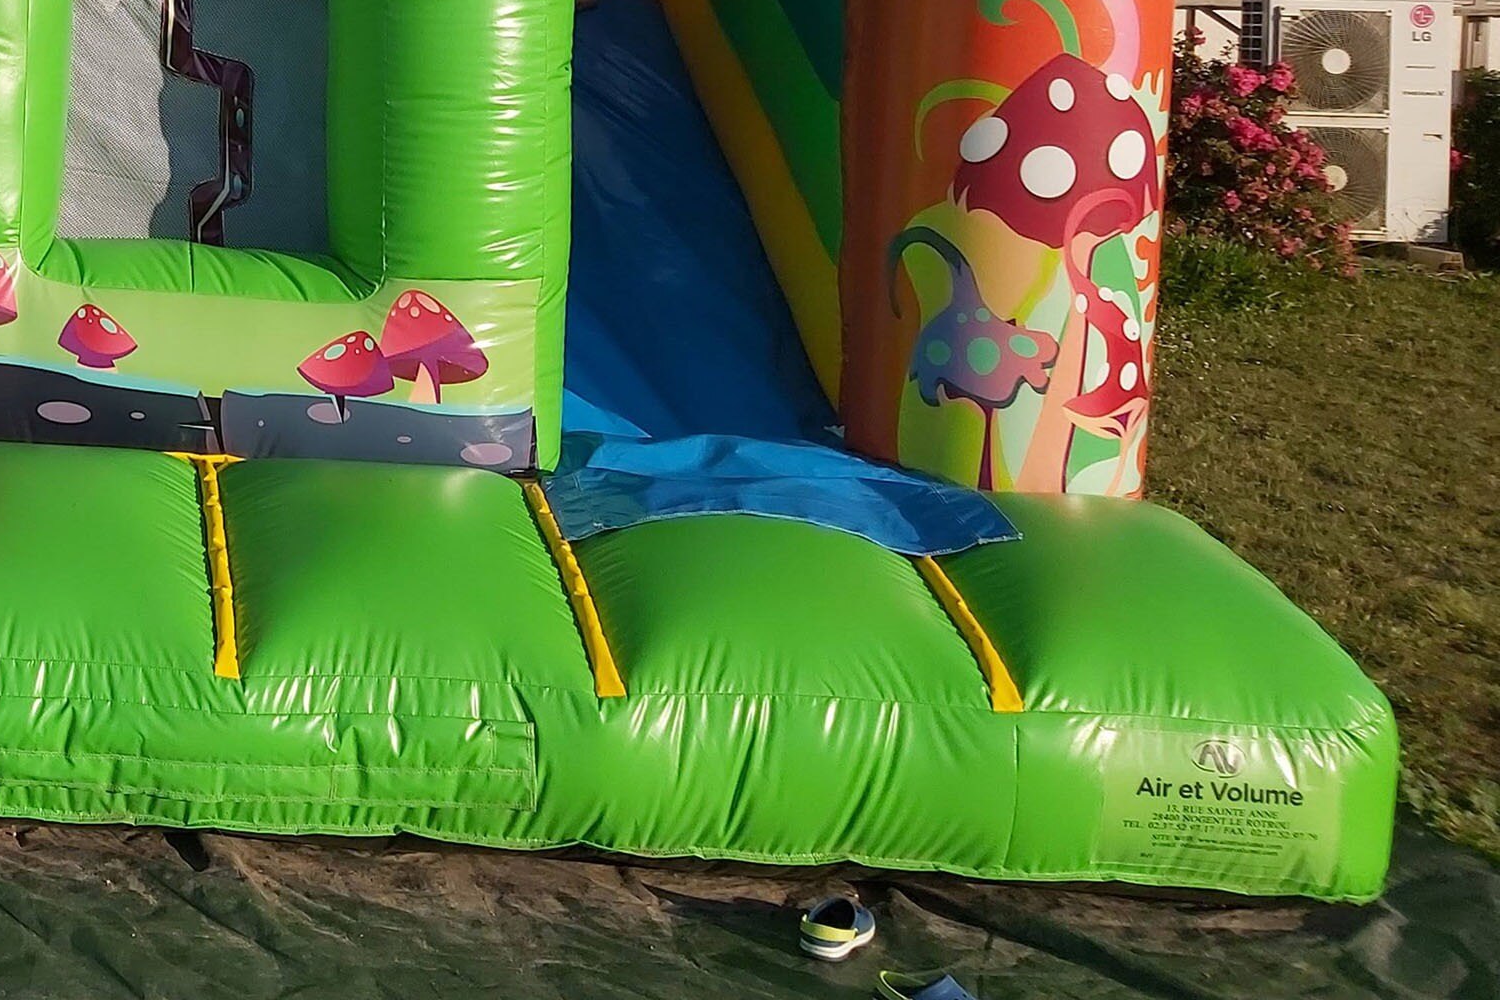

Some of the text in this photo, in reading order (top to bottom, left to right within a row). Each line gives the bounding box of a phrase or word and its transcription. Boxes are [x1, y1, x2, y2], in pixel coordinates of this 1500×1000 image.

[1411, 30, 1432, 42] LG
[1136, 776, 1304, 807] Air et Volume
[1182, 804, 1203, 815] RUE
[1206, 806, 1246, 817] SAINTE
[1249, 809, 1279, 820] ANNE
[1182, 813, 1228, 825] NOGENT
[1229, 817, 1243, 826] LE
